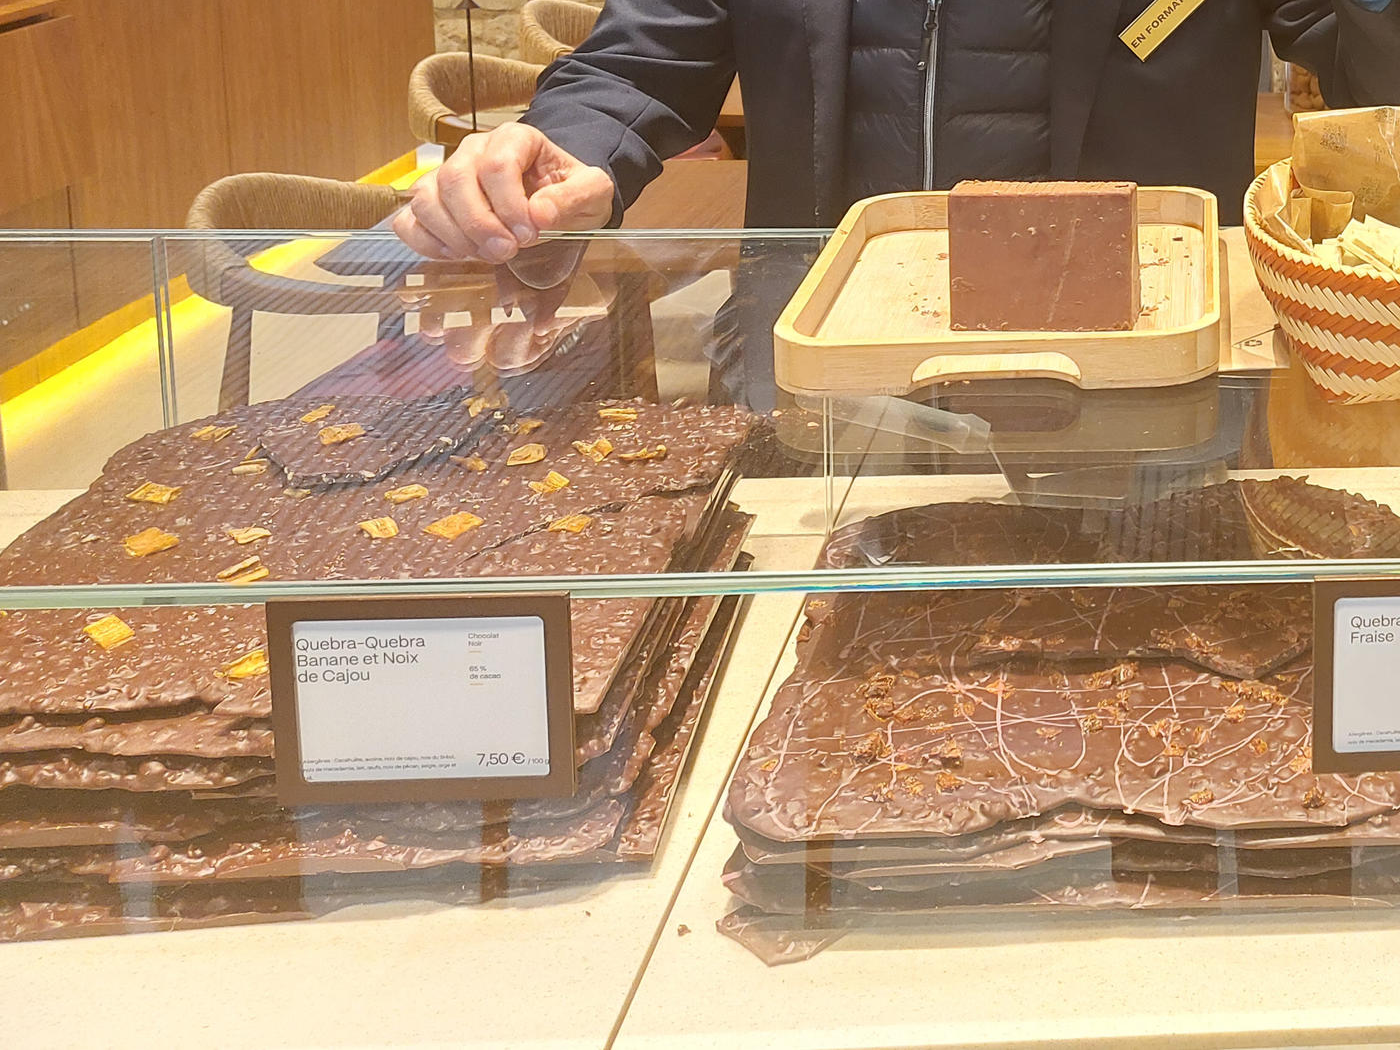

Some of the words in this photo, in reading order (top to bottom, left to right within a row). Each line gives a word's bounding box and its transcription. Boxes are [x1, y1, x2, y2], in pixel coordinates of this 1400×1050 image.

[1130, 33, 1147, 49] EN
[295, 635, 426, 652] Quebra-Quebra
[1350, 630, 1394, 644] Fraise
[296, 653, 359, 668] Banane
[362, 652, 379, 665] et
[383, 651, 419, 665] Noix
[297, 669, 319, 683] de
[322, 668, 371, 685] Cajou
[476, 753, 509, 767] 7,50
[511, 752, 526, 765] €
